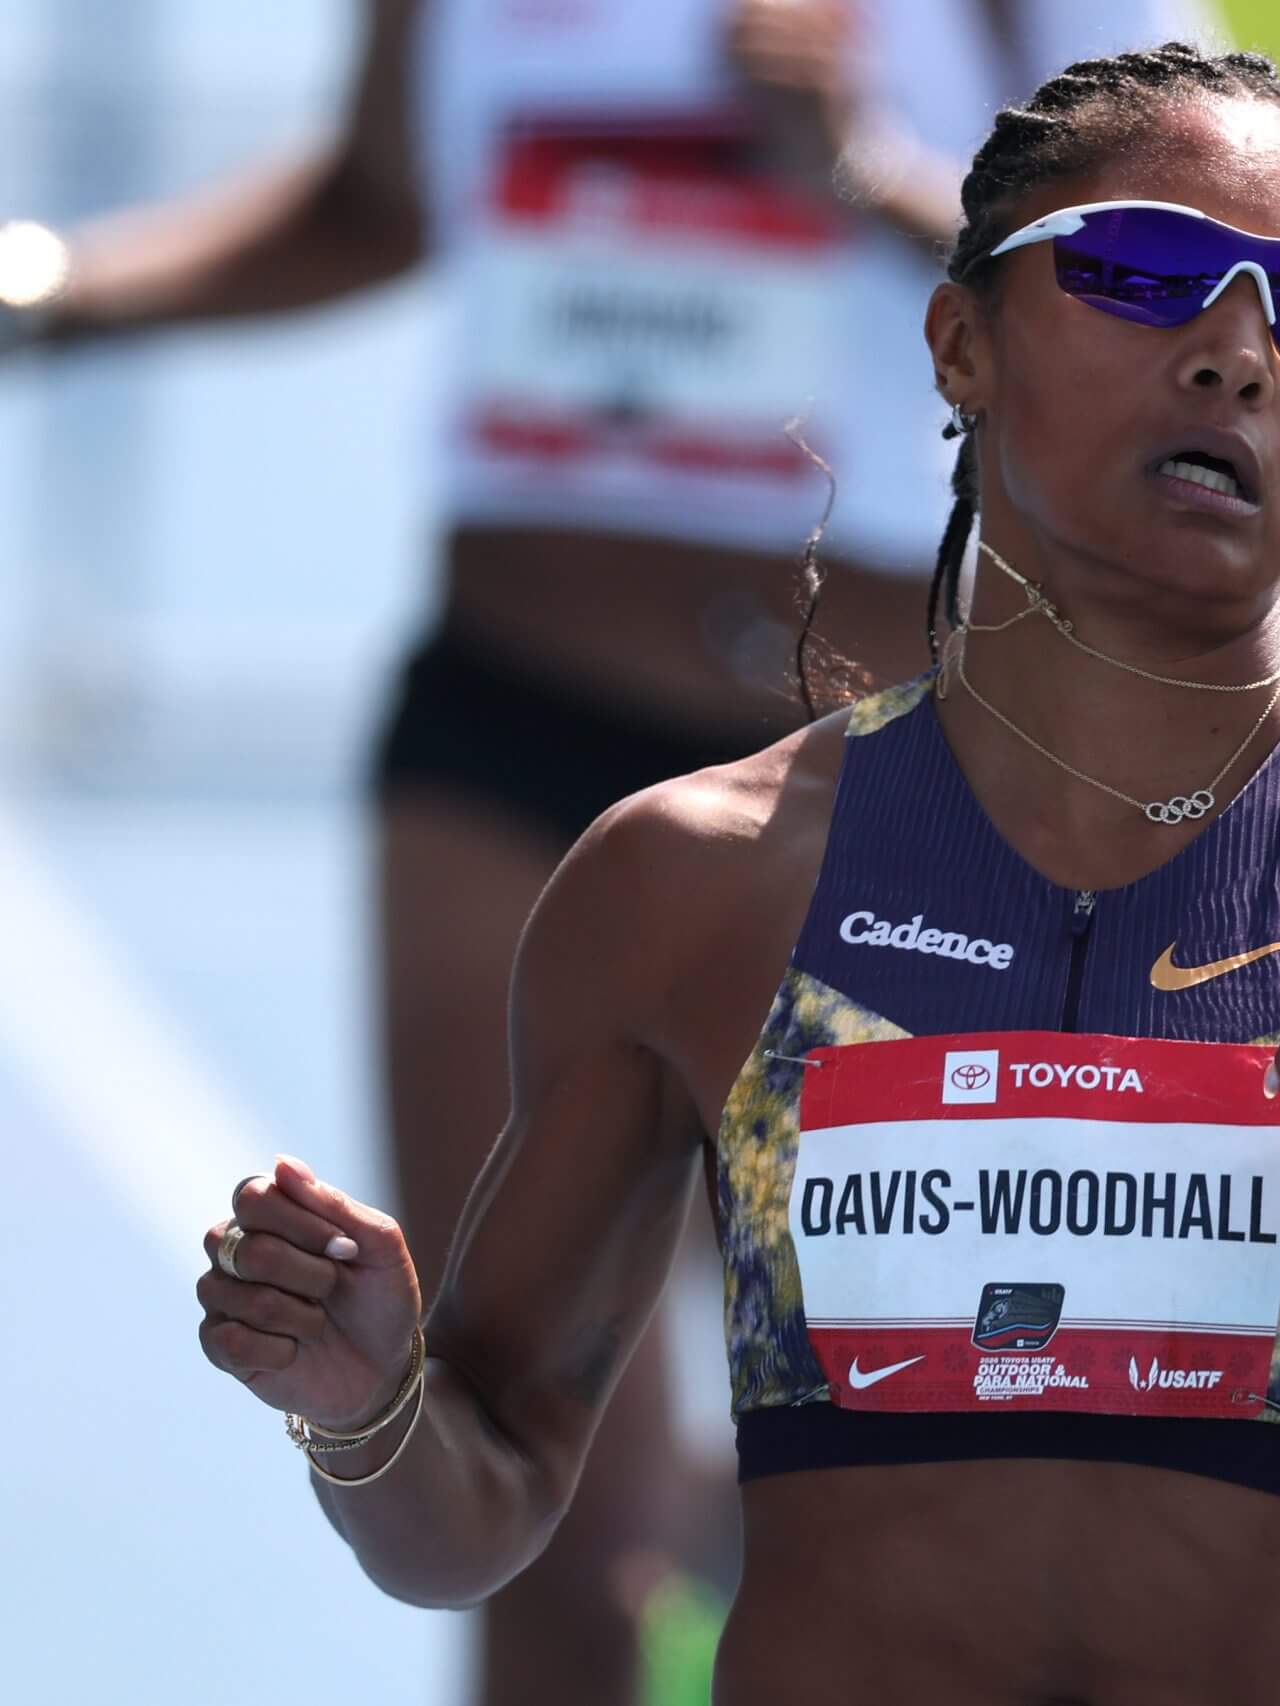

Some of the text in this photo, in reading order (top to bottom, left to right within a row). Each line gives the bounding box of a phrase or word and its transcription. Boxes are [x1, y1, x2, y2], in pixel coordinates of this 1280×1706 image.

[839, 910, 1015, 970] Cadence
[1009, 1063, 1144, 1093] TOYOTA
[800, 1168, 1278, 1244] DAVIS-WOODHALL
[973, 1375, 1089, 1388] PARA NATIONAL
[978, 1364, 1065, 1376] OUTDOOR &
[1158, 1370, 1224, 1389] USATF
